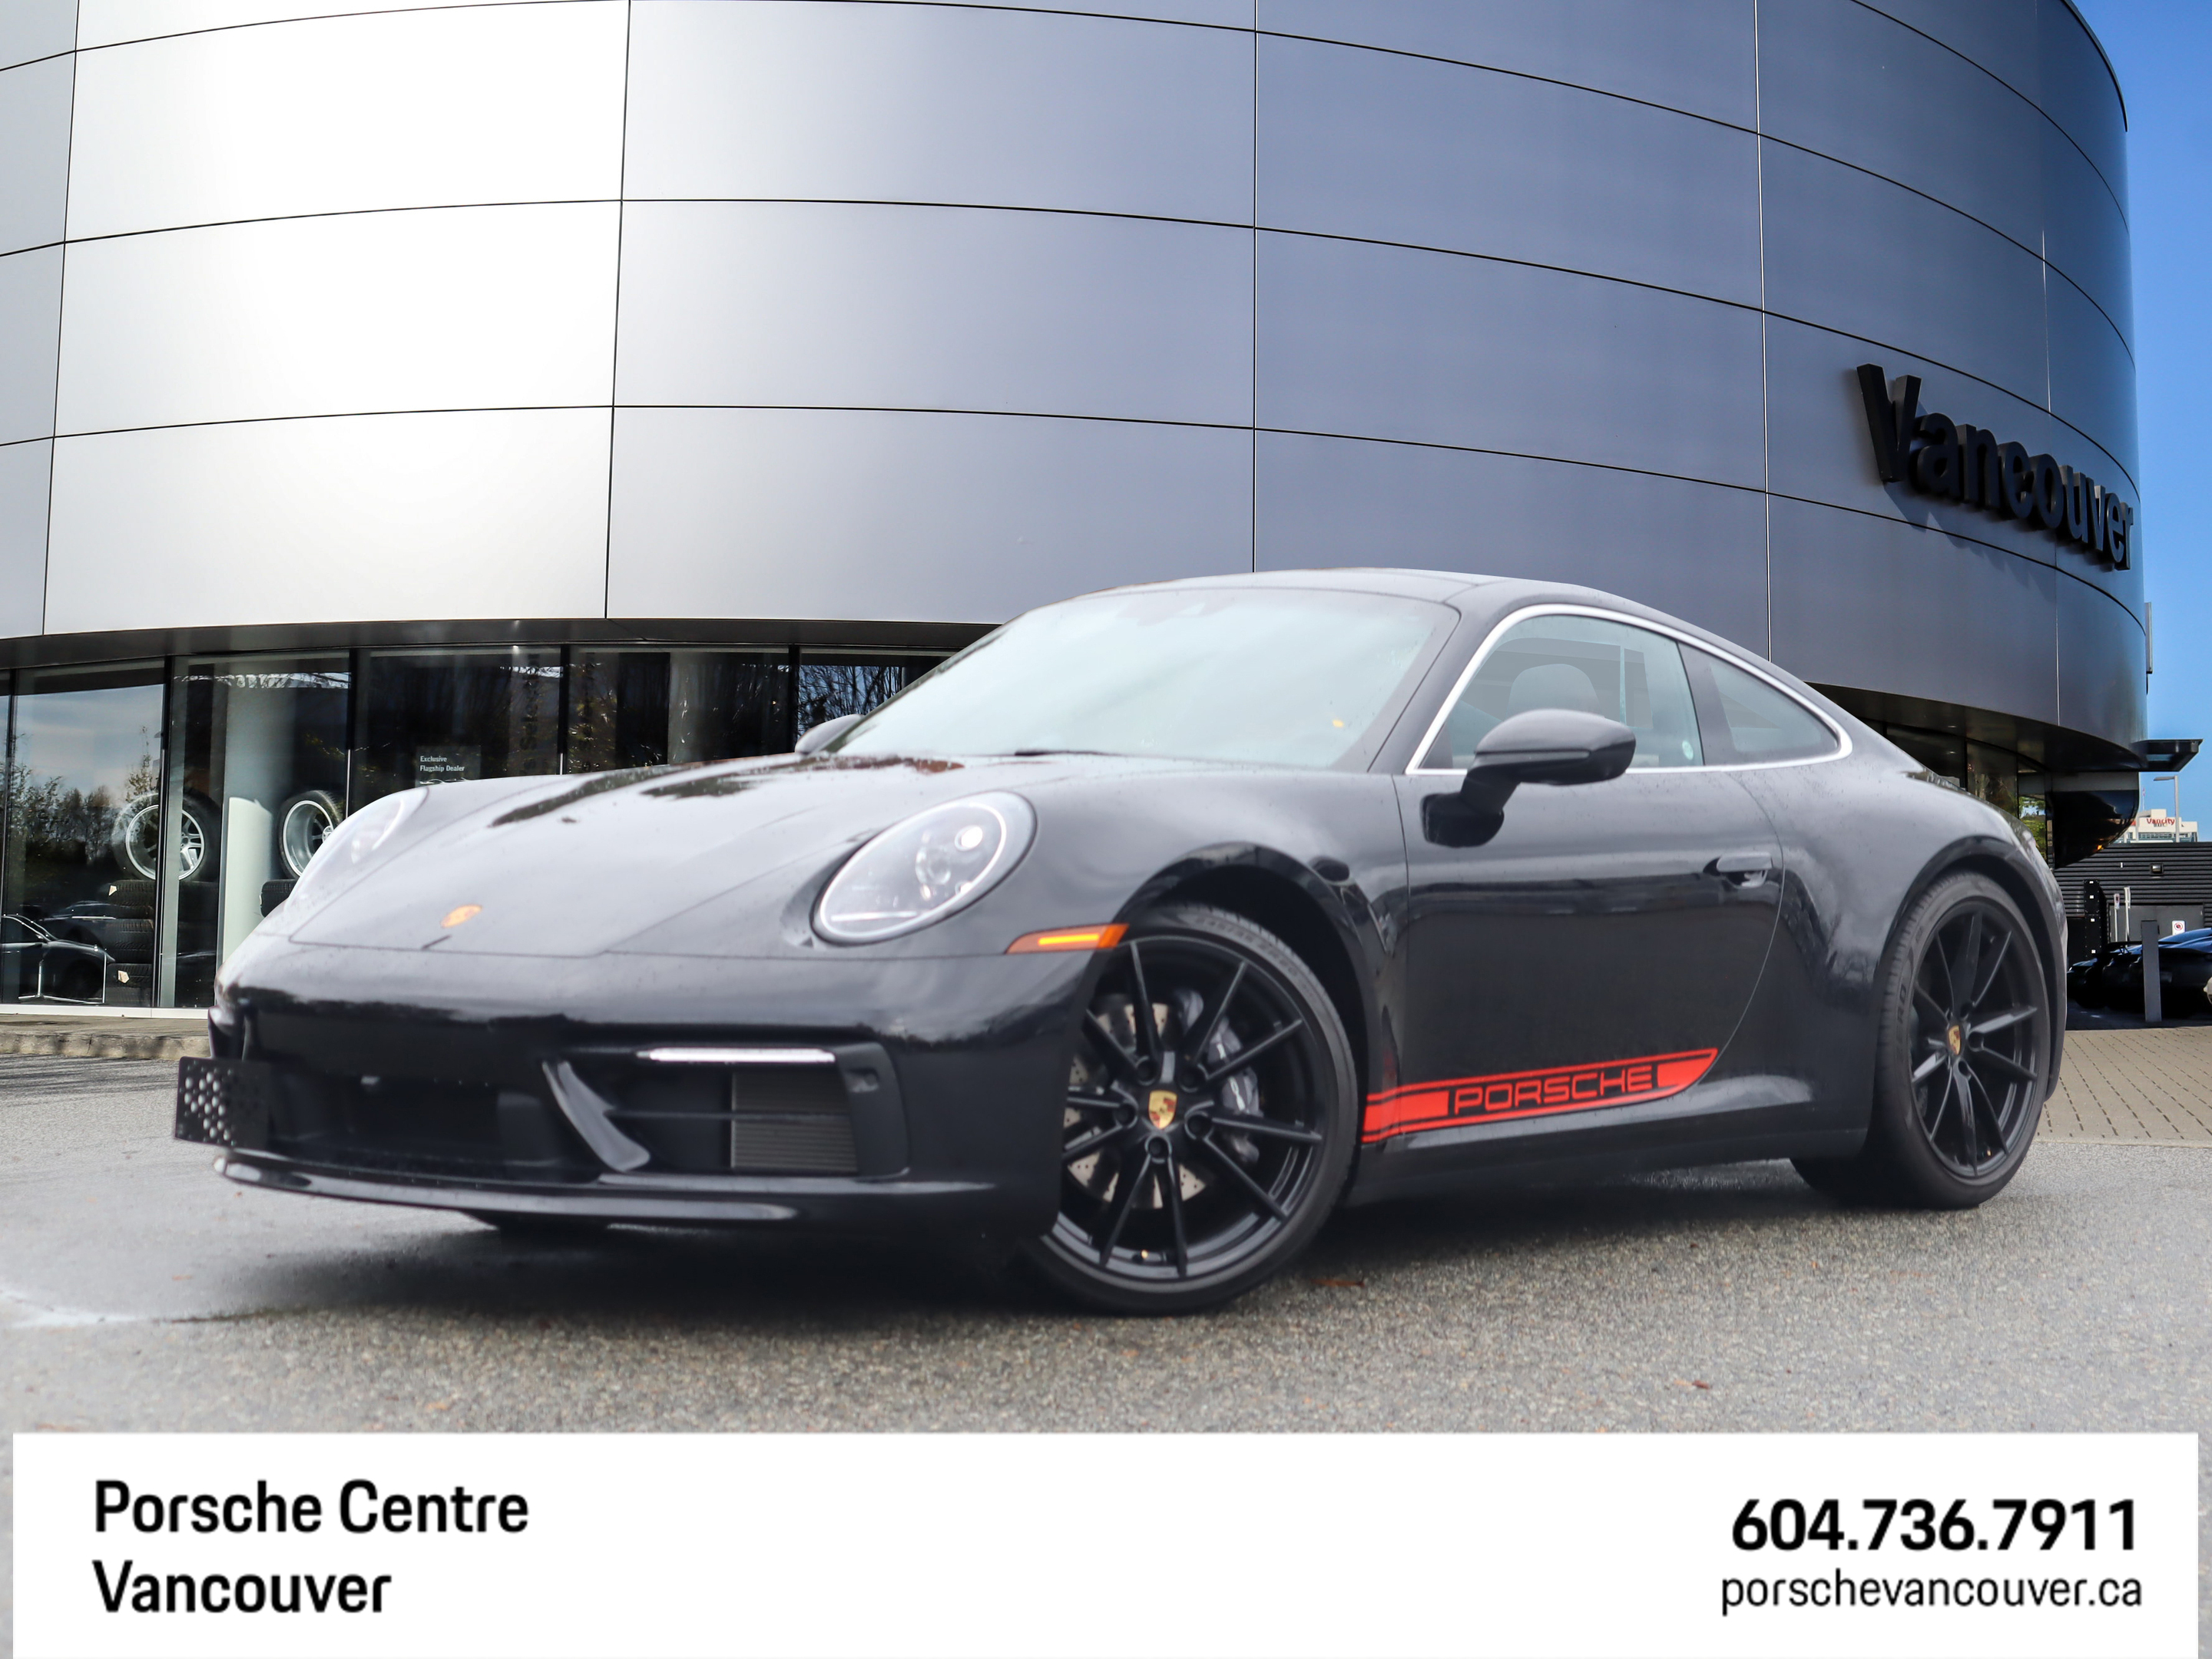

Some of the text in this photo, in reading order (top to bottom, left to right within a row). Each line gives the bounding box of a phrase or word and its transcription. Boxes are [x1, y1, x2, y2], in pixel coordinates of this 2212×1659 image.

[1856, 363, 2134, 571] Vancouver
[2147, 817, 2175, 826] Vancity
[1454, 1065, 1653, 1115] PORSCHE
